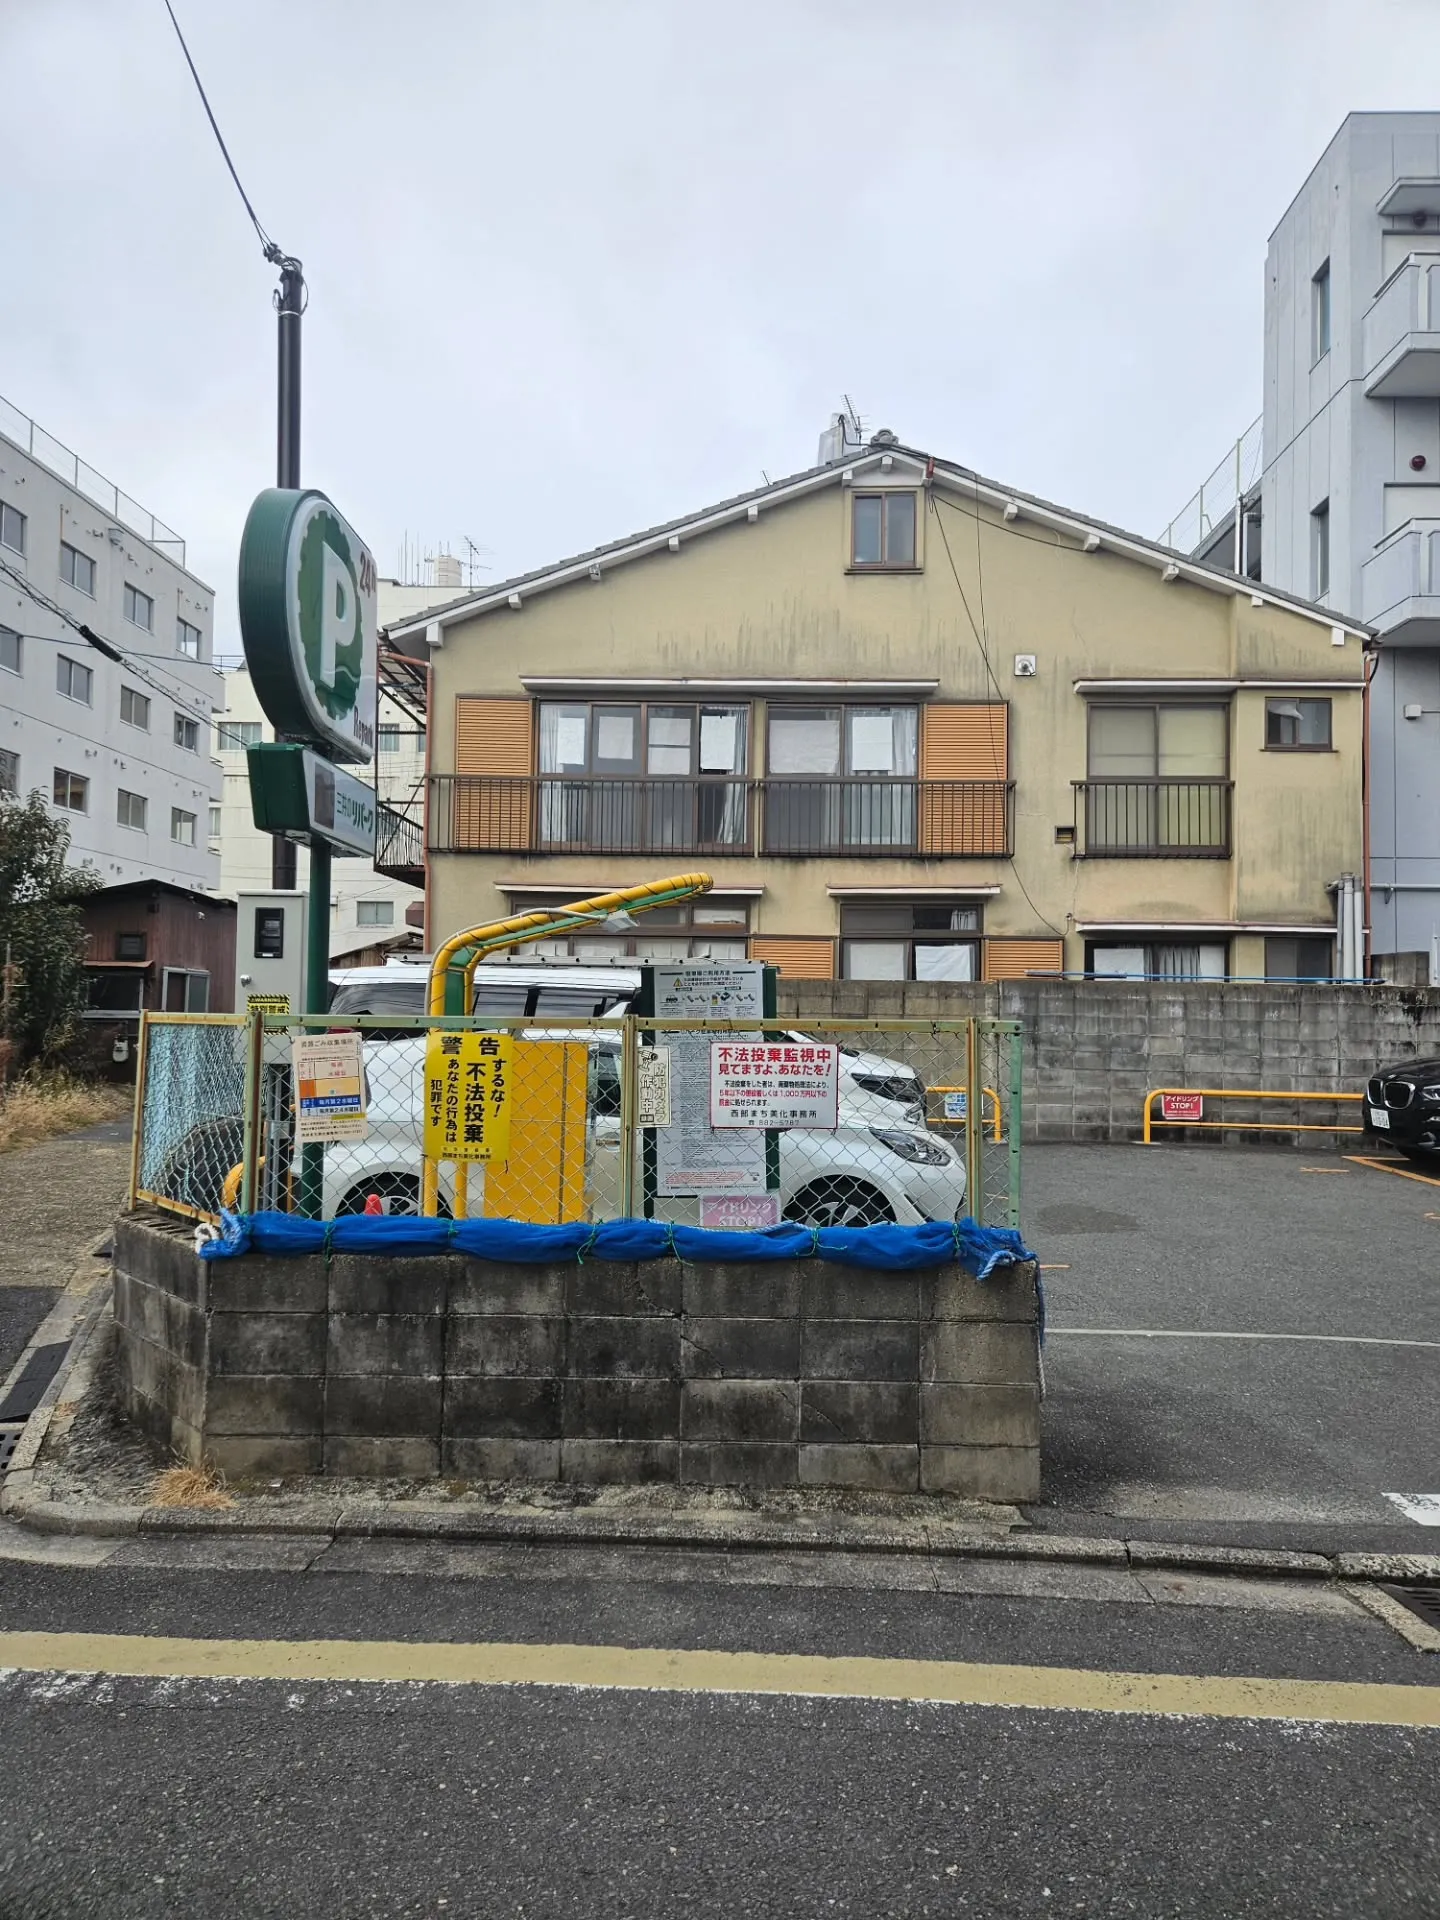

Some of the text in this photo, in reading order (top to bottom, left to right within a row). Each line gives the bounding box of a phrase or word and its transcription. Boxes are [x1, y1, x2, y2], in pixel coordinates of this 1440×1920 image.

[320, 541, 356, 688] P
[718, 1047, 831, 1062] 不法投棄監視中
[430, 1079, 443, 1127] 犯罪です
[445, 1058, 460, 1142] あなたの行為は
[464, 1062, 487, 1144] 不法投棄
[640, 1073, 654, 1113] 作動中
[654, 1063, 667, 1123] 防犯カメラ
[730, 1109, 817, 1119] 西部まち美化事務所
